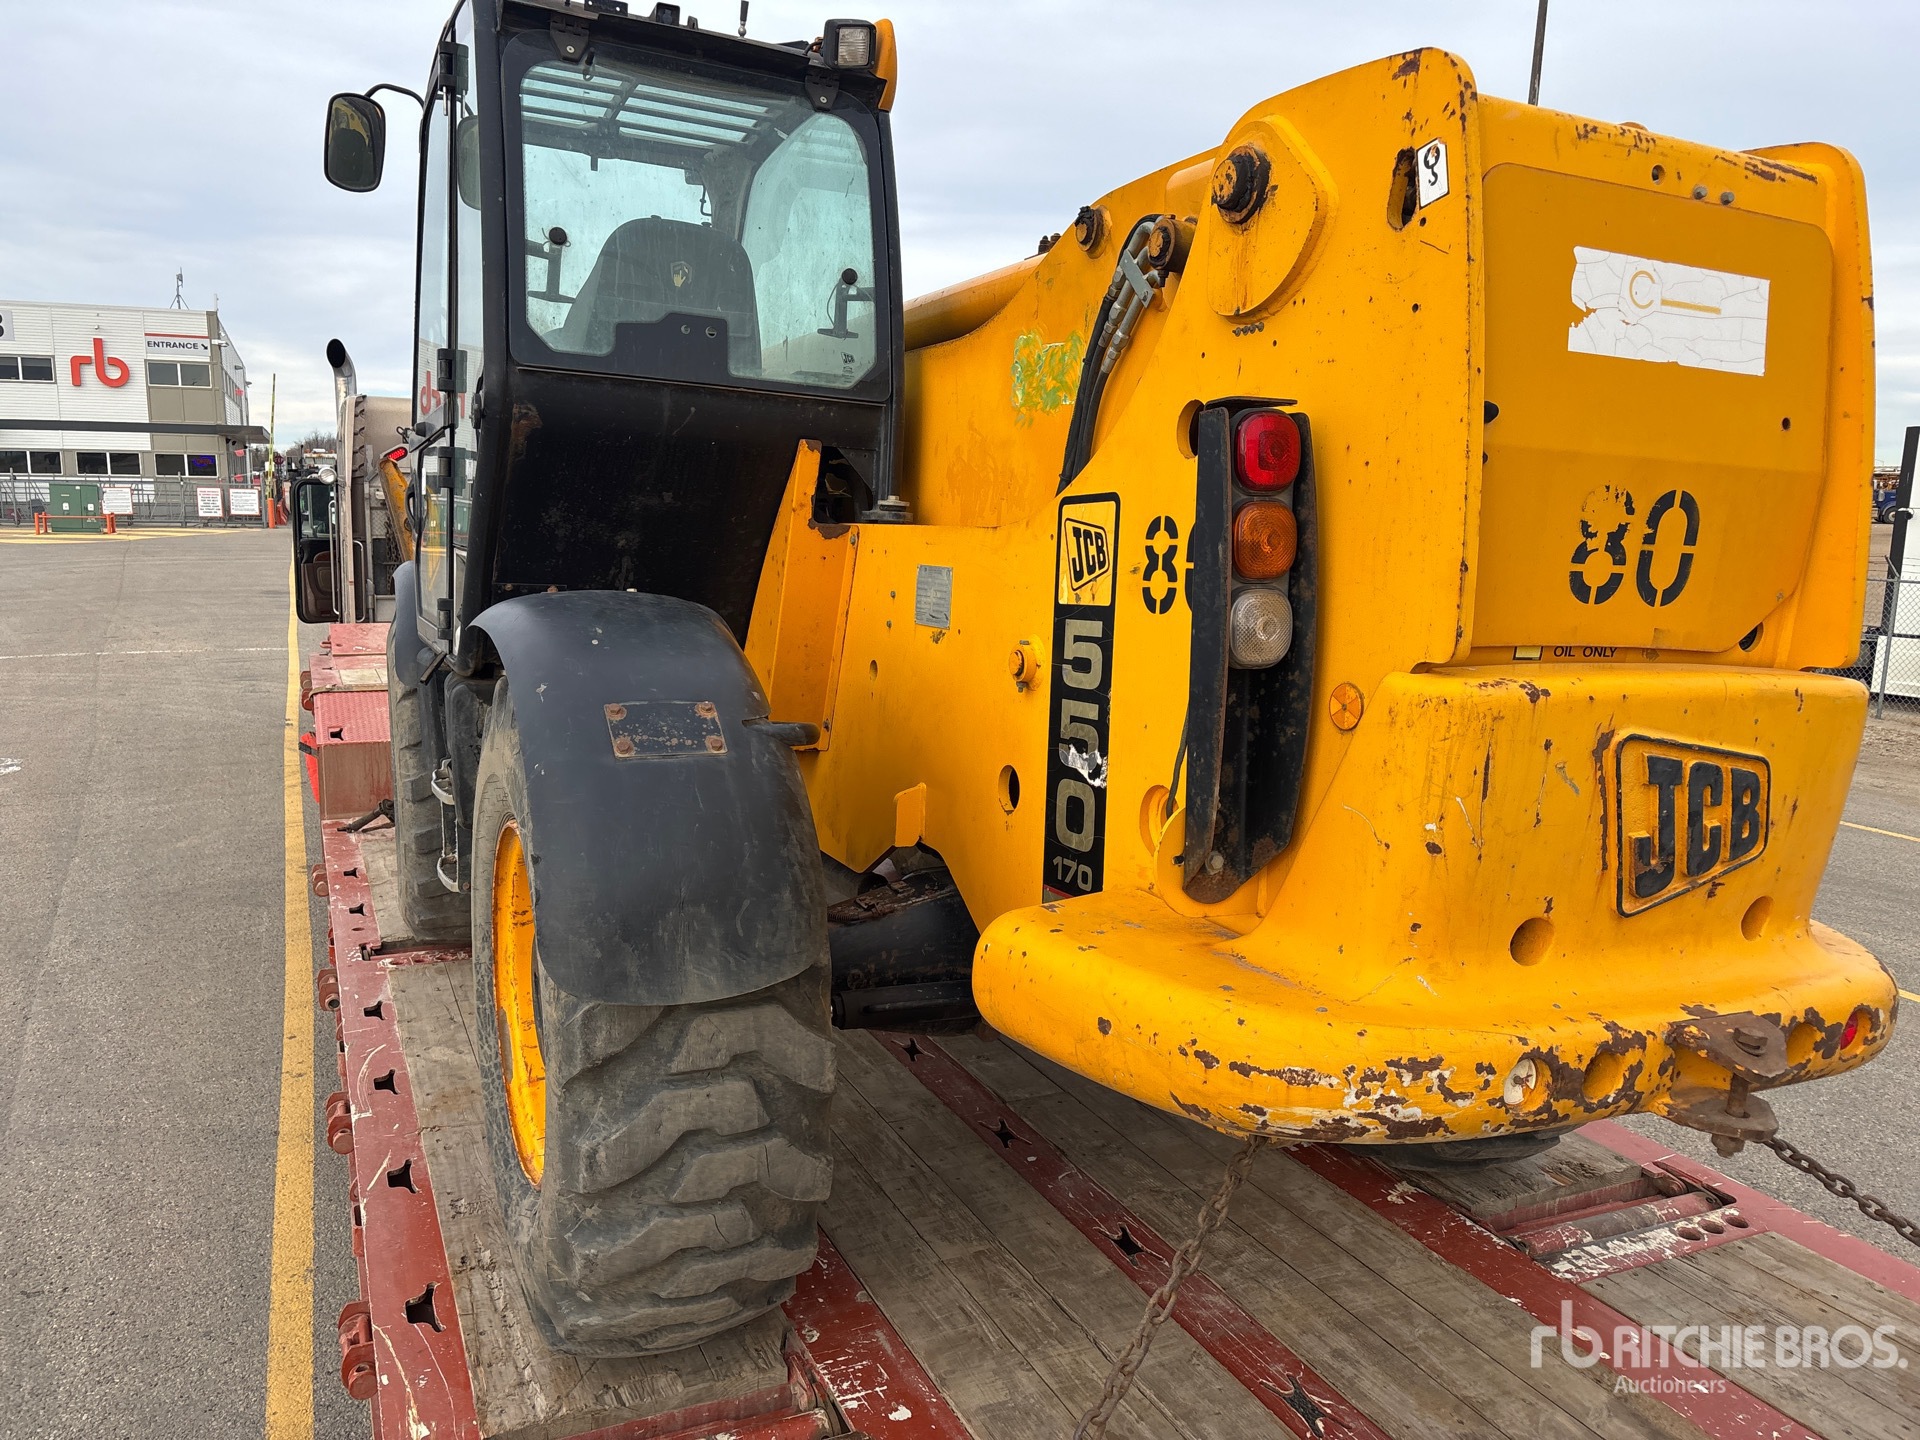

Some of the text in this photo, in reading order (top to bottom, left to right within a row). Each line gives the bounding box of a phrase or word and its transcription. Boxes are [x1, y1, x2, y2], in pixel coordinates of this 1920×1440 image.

[70, 338, 130, 388] rb
[147, 341, 199, 350] ENTRANCE
[1071, 526, 1108, 583] JCB
[1142, 515, 1196, 614] 8
[1568, 483, 1700, 607] 80
[1553, 646, 1618, 658] OIL ONLY
[1628, 752, 1762, 899] JCB
[1052, 856, 1093, 892] 170
